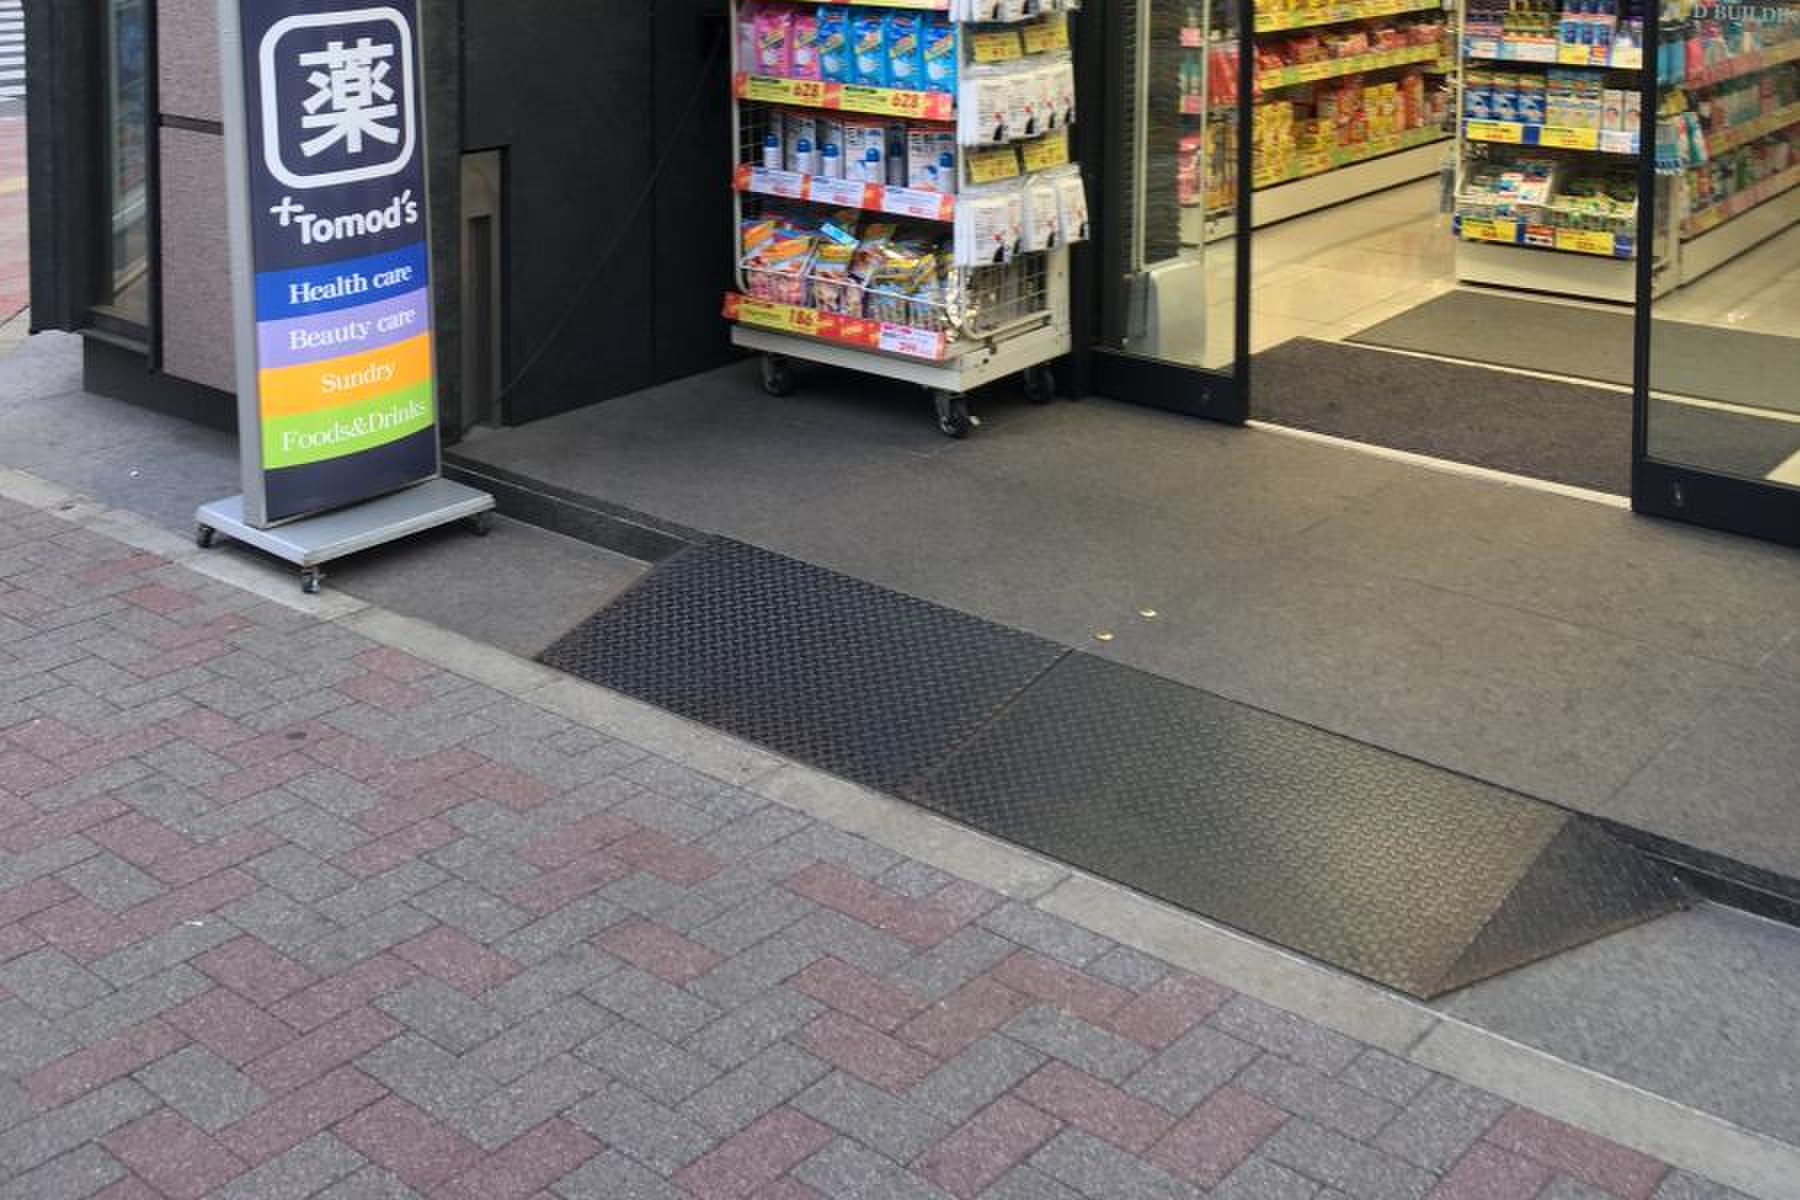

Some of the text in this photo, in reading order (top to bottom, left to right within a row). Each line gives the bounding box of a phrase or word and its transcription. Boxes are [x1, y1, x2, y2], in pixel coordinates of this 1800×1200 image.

[298, 38, 400, 159] 薬
[298, 189, 418, 246] Tomod's
[288, 263, 412, 305] Health care
[288, 308, 416, 351] Beauty care
[320, 361, 397, 395] Sundry
[280, 401, 427, 453] Foods&Drinks
